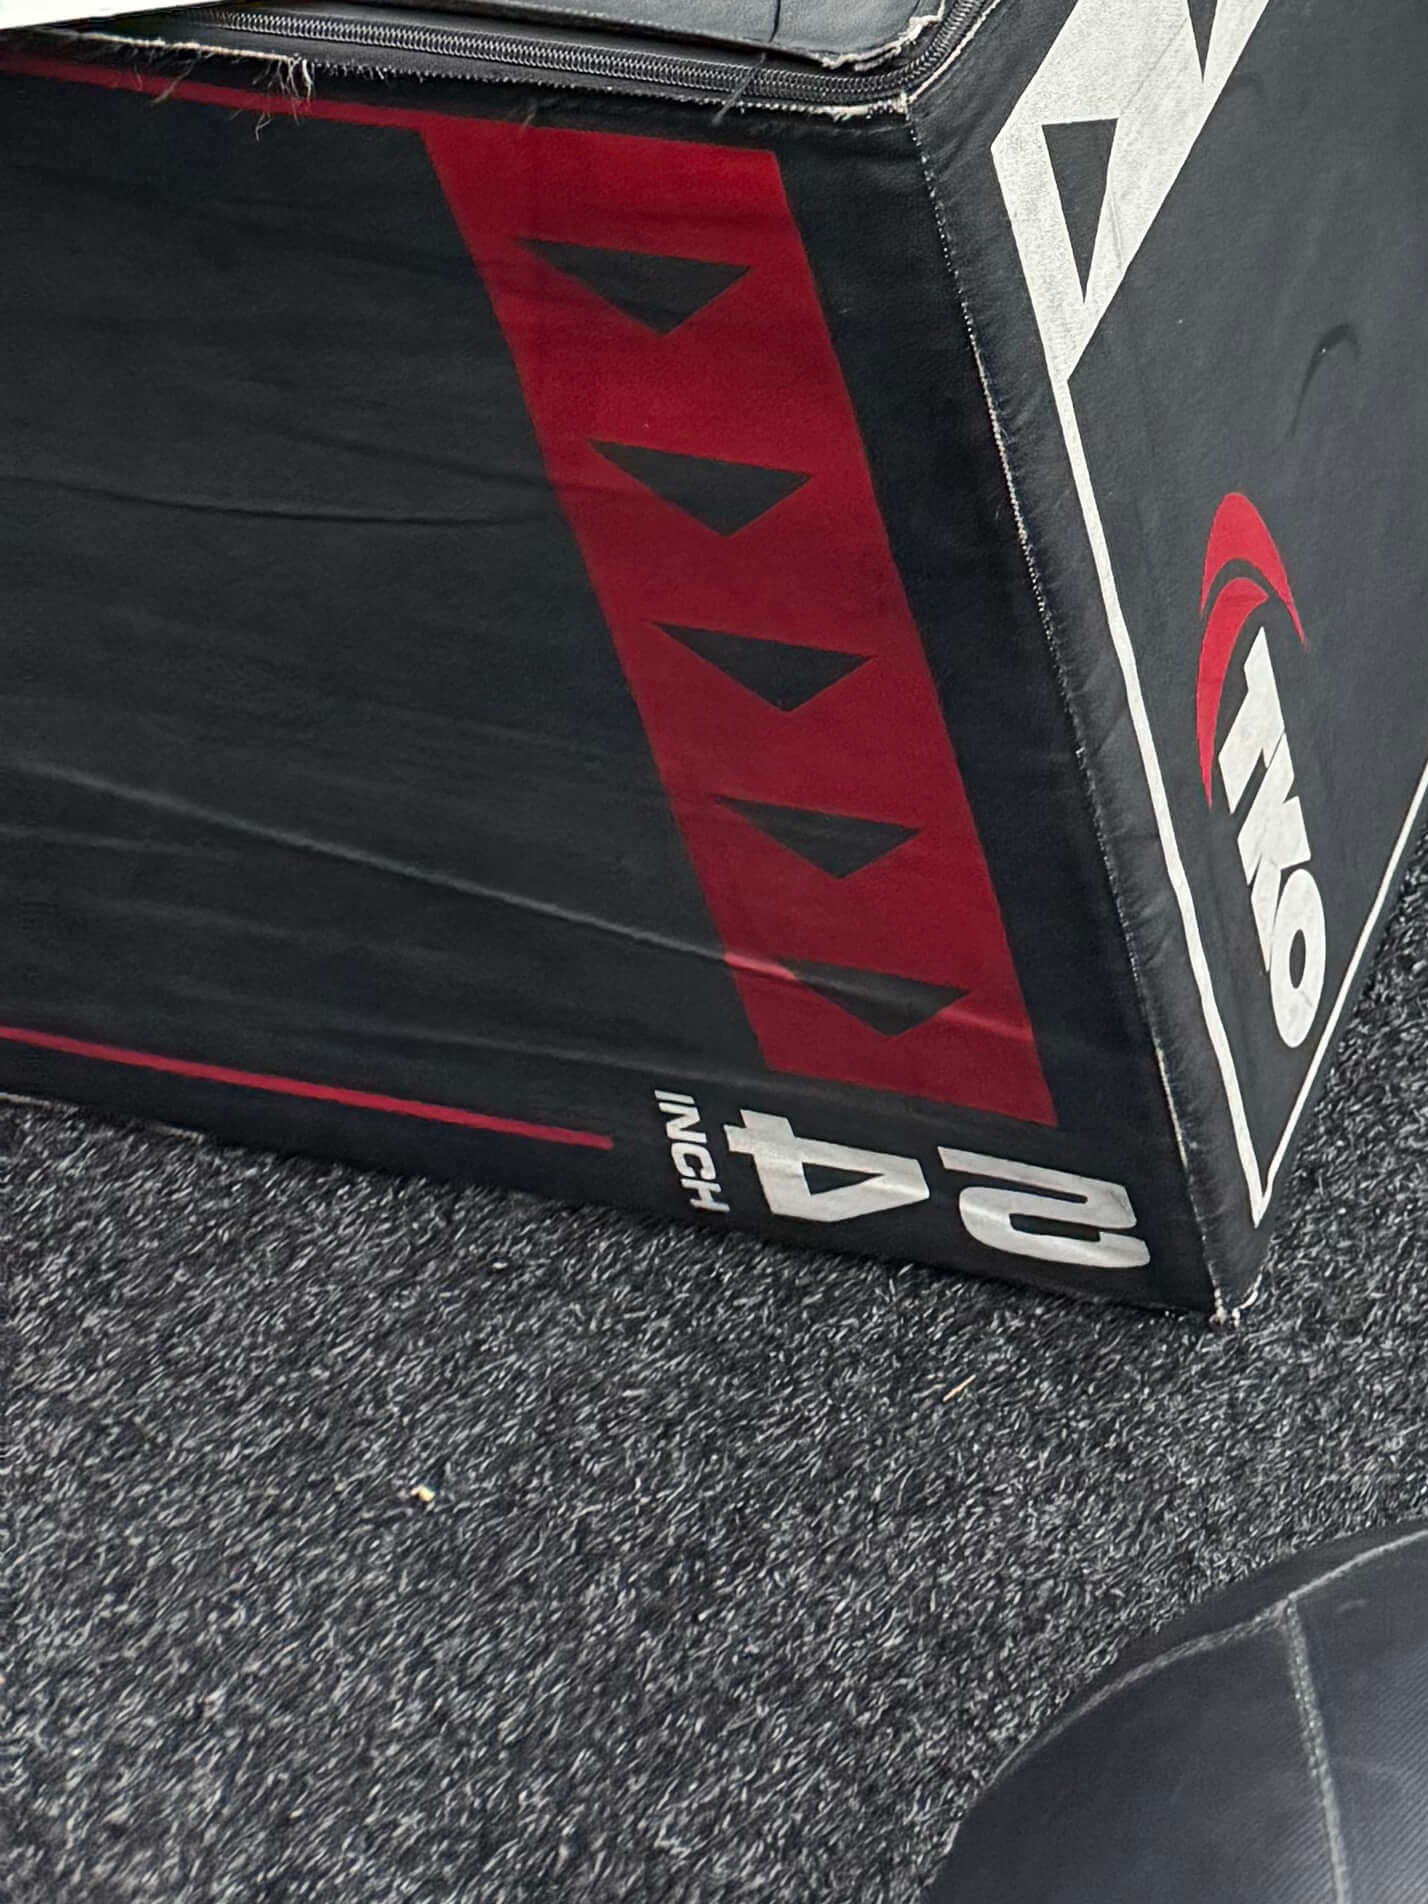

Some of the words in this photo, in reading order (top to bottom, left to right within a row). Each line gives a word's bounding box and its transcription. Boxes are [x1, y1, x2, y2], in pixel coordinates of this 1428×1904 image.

[1218, 625, 1327, 1049] TKO
[653, 1089, 721, 1215] INCH
[726, 1107, 1153, 1270] 24
